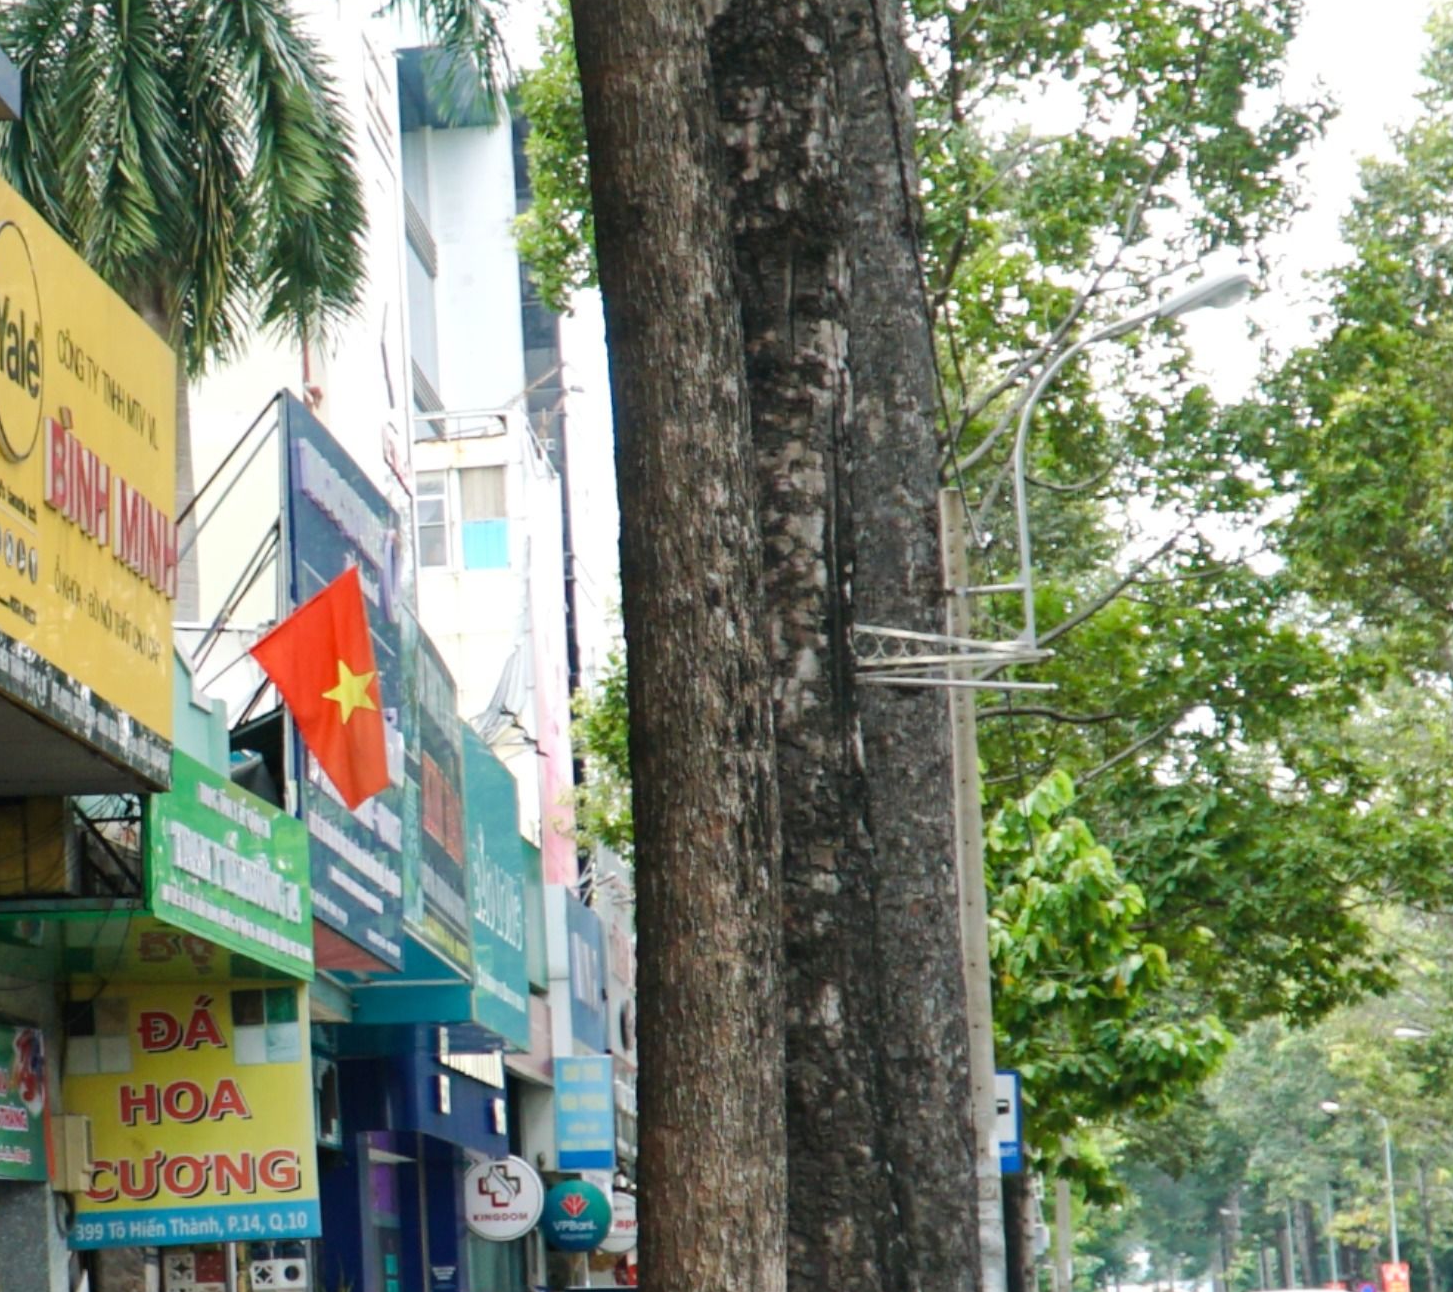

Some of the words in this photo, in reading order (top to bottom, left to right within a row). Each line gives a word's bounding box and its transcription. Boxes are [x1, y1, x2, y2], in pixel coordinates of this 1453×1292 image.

[44, 405, 110, 549] BÌNH
[113, 475, 179, 601] MINH
[138, 995, 225, 1053] ĐÁ
[120, 1079, 251, 1127] HOA
[87, 1149, 303, 1203] CƯƠNG
[75, 1221, 103, 1241] 399
[108, 1220, 126, 1240] Tô
[129, 1215, 167, 1238] Hiến
[168, 1215, 225, 1237] Thành,
[269, 1211, 308, 1231] Q.10
[472, 1212, 529, 1222] KINGDOM
